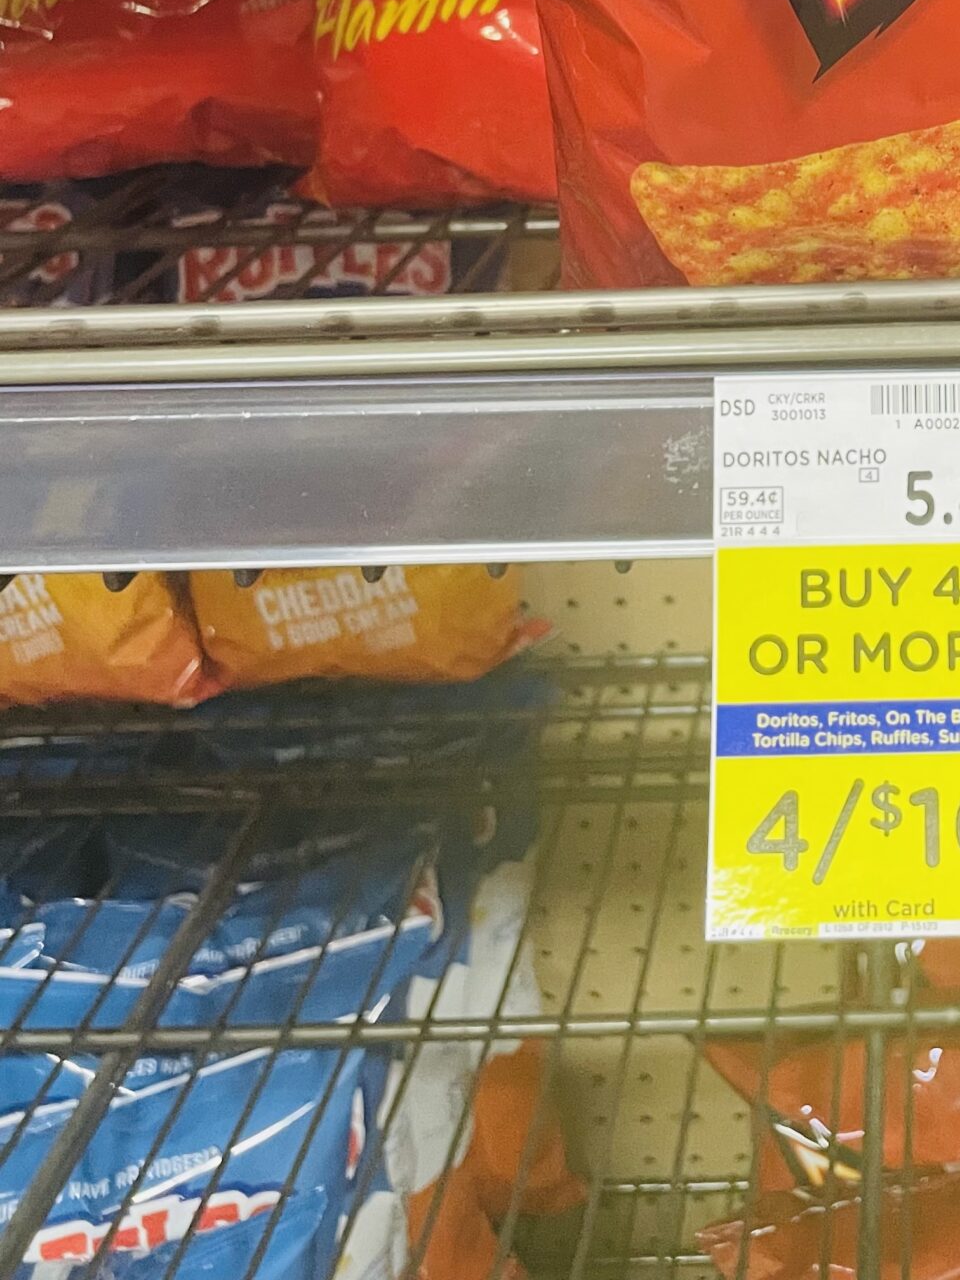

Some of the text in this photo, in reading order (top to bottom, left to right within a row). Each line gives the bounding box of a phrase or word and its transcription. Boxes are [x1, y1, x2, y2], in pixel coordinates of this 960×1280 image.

[720, 399, 756, 417] DSD
[768, 392, 826, 405] CKY/CRKR
[771, 409, 826, 421] 3001013
[723, 448, 888, 468] DORITOS NACHO
[864, 471, 874, 482] 4
[727, 491, 779, 507] 59.4¢
[724, 509, 781, 521] PER OUNCE
[800, 566, 913, 610] BUY
[748, 632, 829, 676] OR
[756, 712, 824, 729] Doritos,
[827, 710, 881, 728] Fritos,
[885, 709, 910, 726] On
[915, 709, 947, 725] The
[752, 732, 810, 749] Tortilla
[814, 731, 867, 749] Chips,
[870, 729, 934, 747] Ruffles,
[833, 898, 936, 919] with Card
